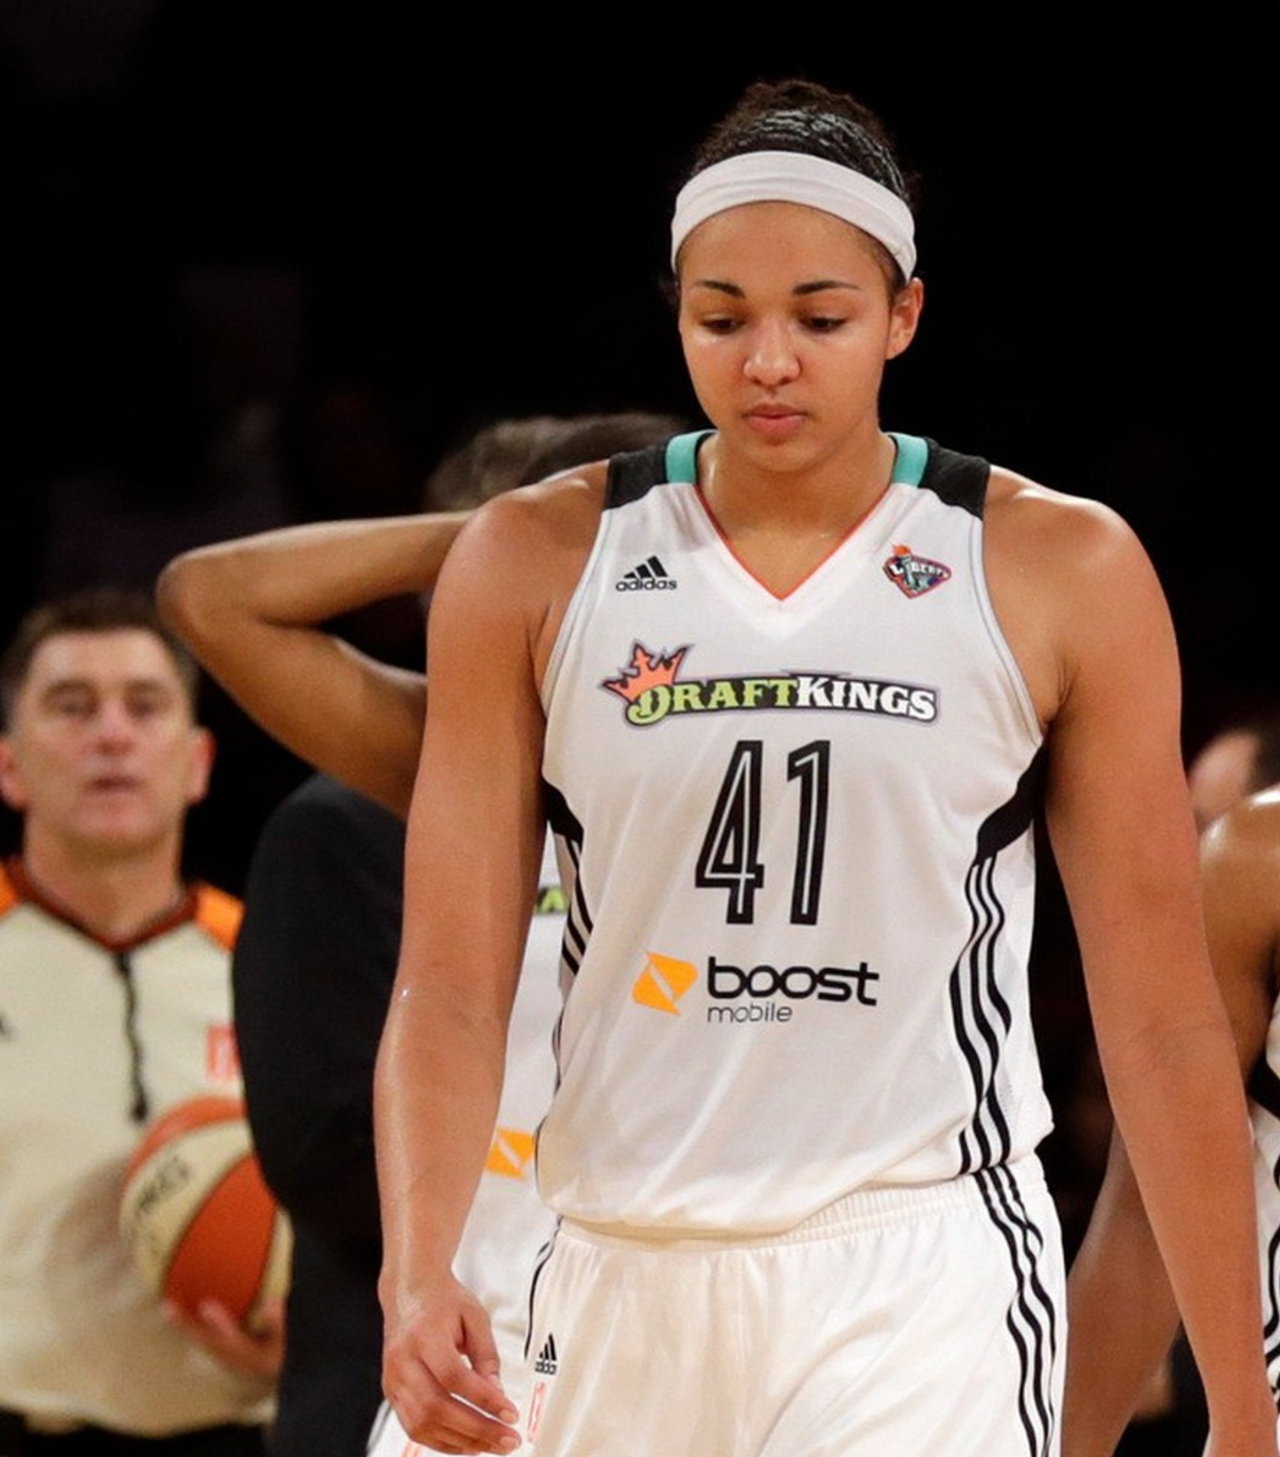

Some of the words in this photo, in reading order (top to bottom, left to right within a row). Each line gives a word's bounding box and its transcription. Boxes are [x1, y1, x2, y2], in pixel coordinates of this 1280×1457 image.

[616, 577, 677, 591] adidas
[627, 674, 937, 725] DRAFTKINGS
[695, 740, 831, 926] 41
[708, 957, 880, 1006] boost
[707, 1002, 793, 1024] mobile
